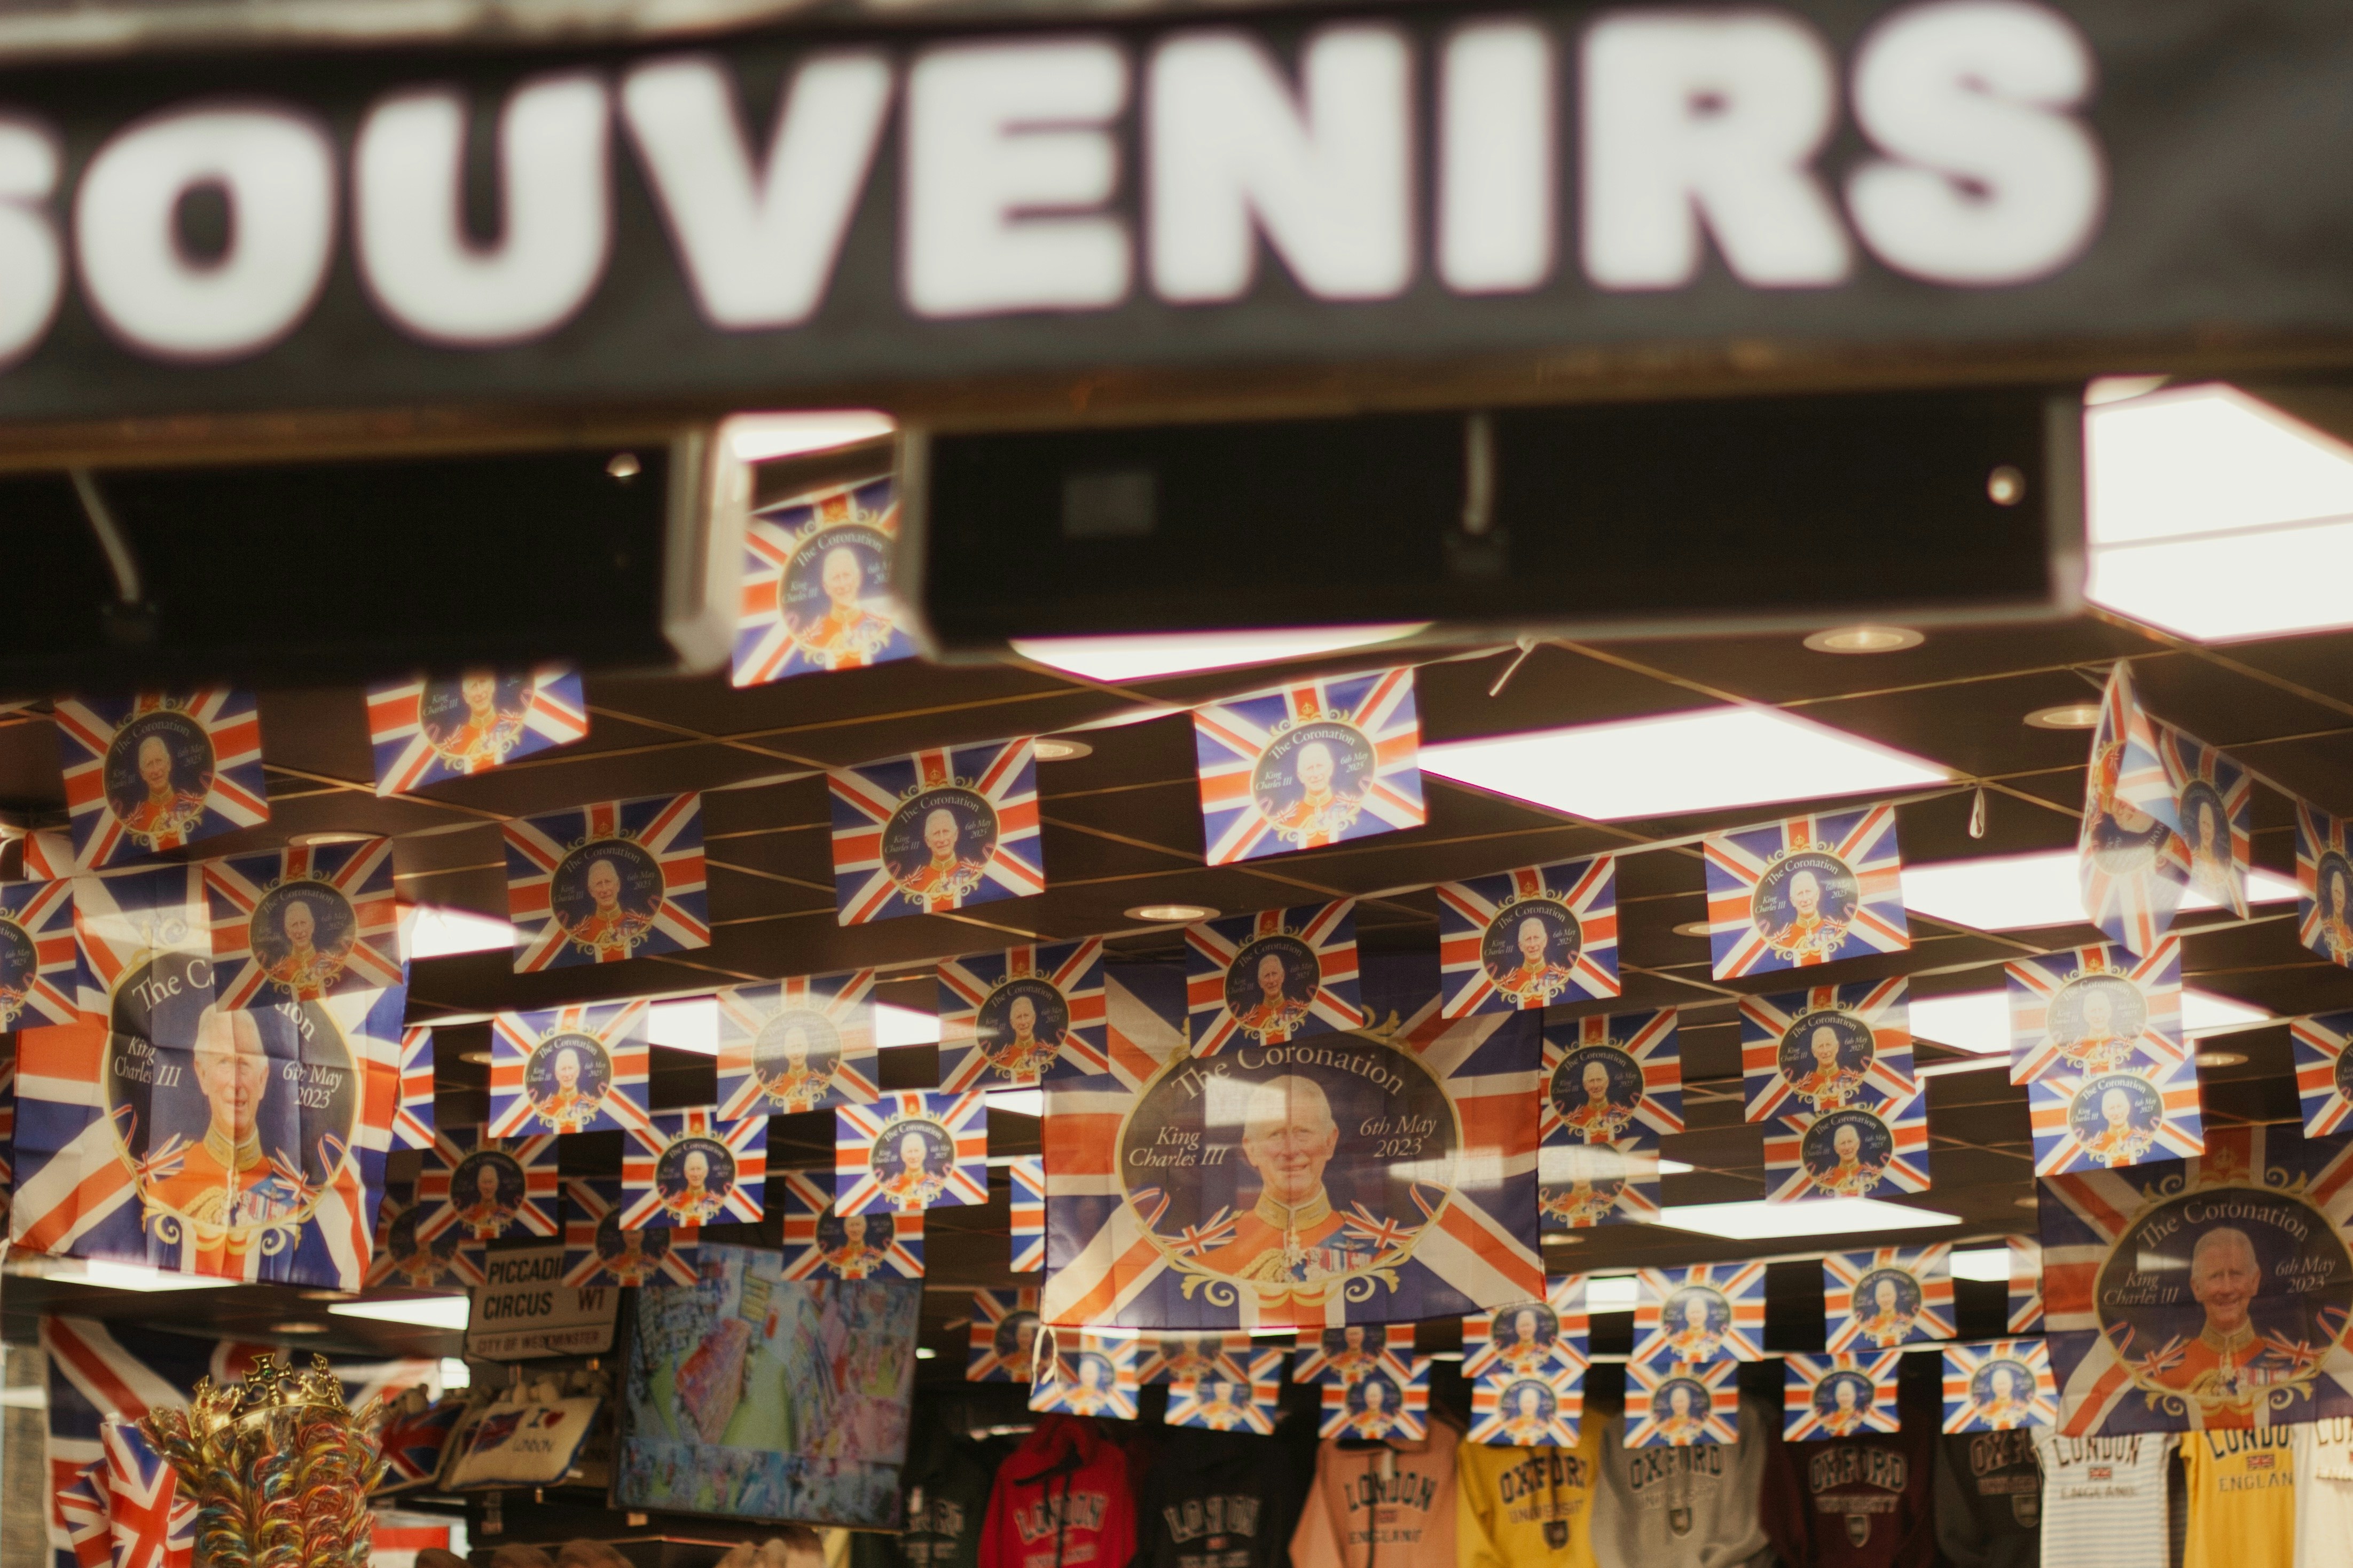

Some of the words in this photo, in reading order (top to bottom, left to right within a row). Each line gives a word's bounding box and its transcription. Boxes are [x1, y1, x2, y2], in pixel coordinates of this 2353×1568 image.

[0, 0, 2104, 367] OUVENIRS
[1268, 742, 1291, 761] The
[1292, 729, 1355, 746] Coronation
[897, 806, 918, 825] The
[920, 795, 979, 813] Coronation
[564, 857, 583, 873] The
[584, 847, 640, 863] Coronation
[1765, 868, 1784, 886] The
[1785, 858, 1839, 875] Coronation
[1825, 883, 1837, 892] 6th
[1838, 880, 1851, 890] May
[1831, 888, 1847, 899] 2023
[1762, 895, 1777, 906] King
[1495, 911, 1513, 930] The
[1515, 906, 1566, 923] Coronation
[132, 974, 182, 1012] The
[1790, 1024, 1807, 1039] The
[1807, 1016, 1857, 1031] Coronation
[128, 1035, 156, 1065] King
[1562, 1057, 1579, 1071] The
[1580, 1051, 1626, 1067] Coronation
[114, 1057, 152, 1083] Charles
[154, 1065, 183, 1087] III
[283, 1060, 307, 1081] 6th
[310, 1065, 342, 1093] May
[1171, 1059, 1231, 1100] The
[1237, 1047, 1405, 1096] Coronation
[294, 1088, 331, 1109] 2023
[2080, 1088, 2097, 1100] The
[2098, 1078, 2146, 1093] Coronation
[1360, 1116, 1391, 1136] 6th
[1396, 1116, 1437, 1140] May
[1813, 1123, 1830, 1135] The
[1830, 1116, 1877, 1130] Coronation
[1156, 1126, 1200, 1151] King
[1374, 1138, 1423, 1159] 2023
[1128, 1146, 1195, 1167] Charles
[1201, 1146, 1229, 1165] III
[2136, 1214, 2180, 1249] The
[2184, 1200, 2310, 1243] Coronation
[488, 1257, 561, 1285] PICCADI
[2276, 1258, 2300, 1277] 6th
[2302, 1256, 2336, 1275] May
[2125, 1272, 2159, 1291] King
[2287, 1277, 2325, 1294] 2023
[483, 1290, 553, 1320] CIRCUS
[578, 1287, 605, 1311] W1
[2104, 1287, 2156, 1306] Charles
[2159, 1286, 2179, 1304] III
[2205, 1425, 2293, 1461] LONDO
[1344, 1471, 1437, 1512] LONDON
[2219, 1472, 2293, 1492] ENGLAN
[1162, 1494, 1261, 1544] LONON
